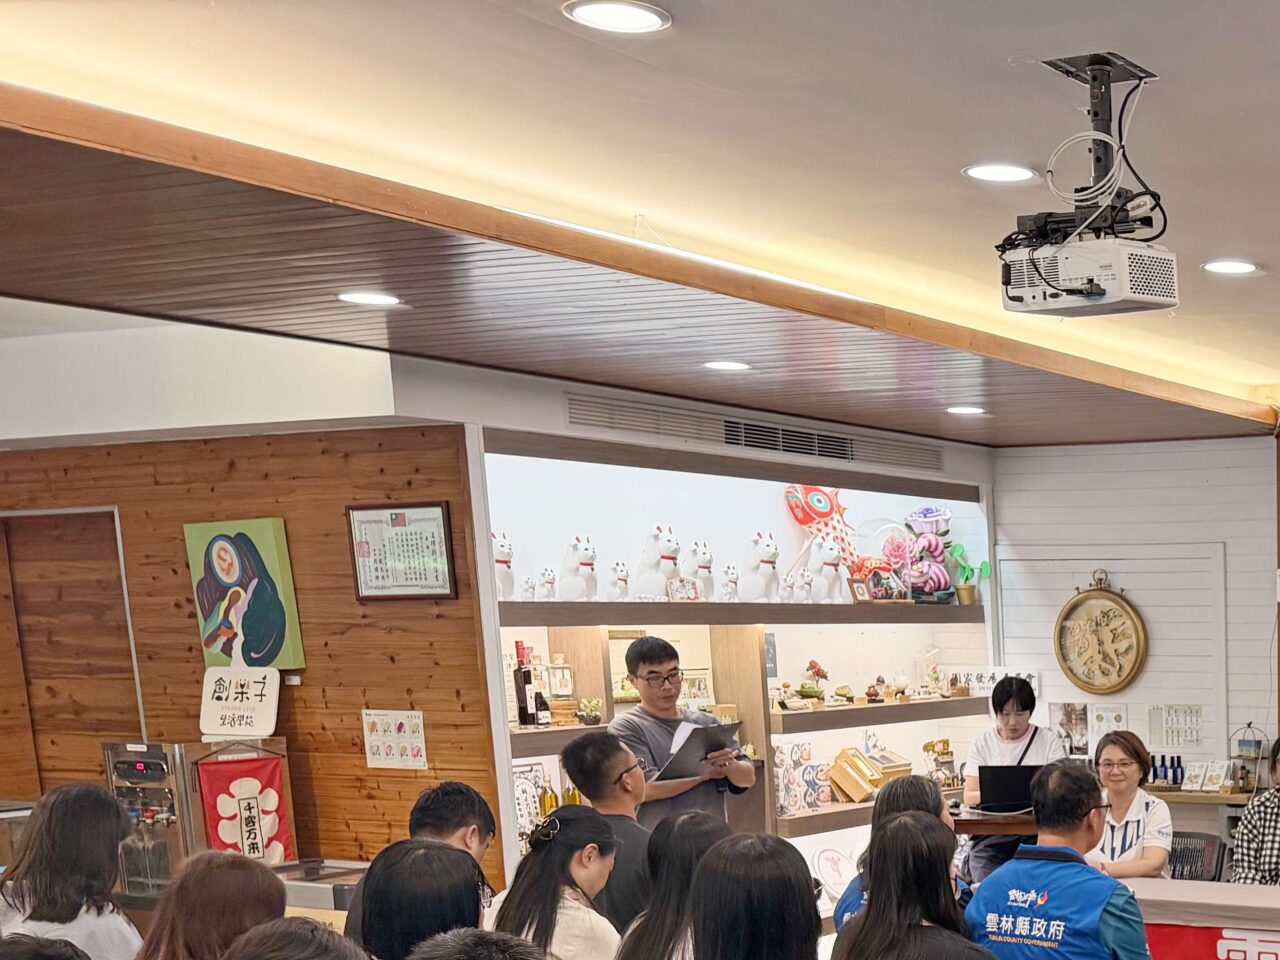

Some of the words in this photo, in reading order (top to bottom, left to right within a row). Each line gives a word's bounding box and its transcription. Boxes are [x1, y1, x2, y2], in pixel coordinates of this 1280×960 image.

[985, 912, 1066, 941] 雲林縣政府
